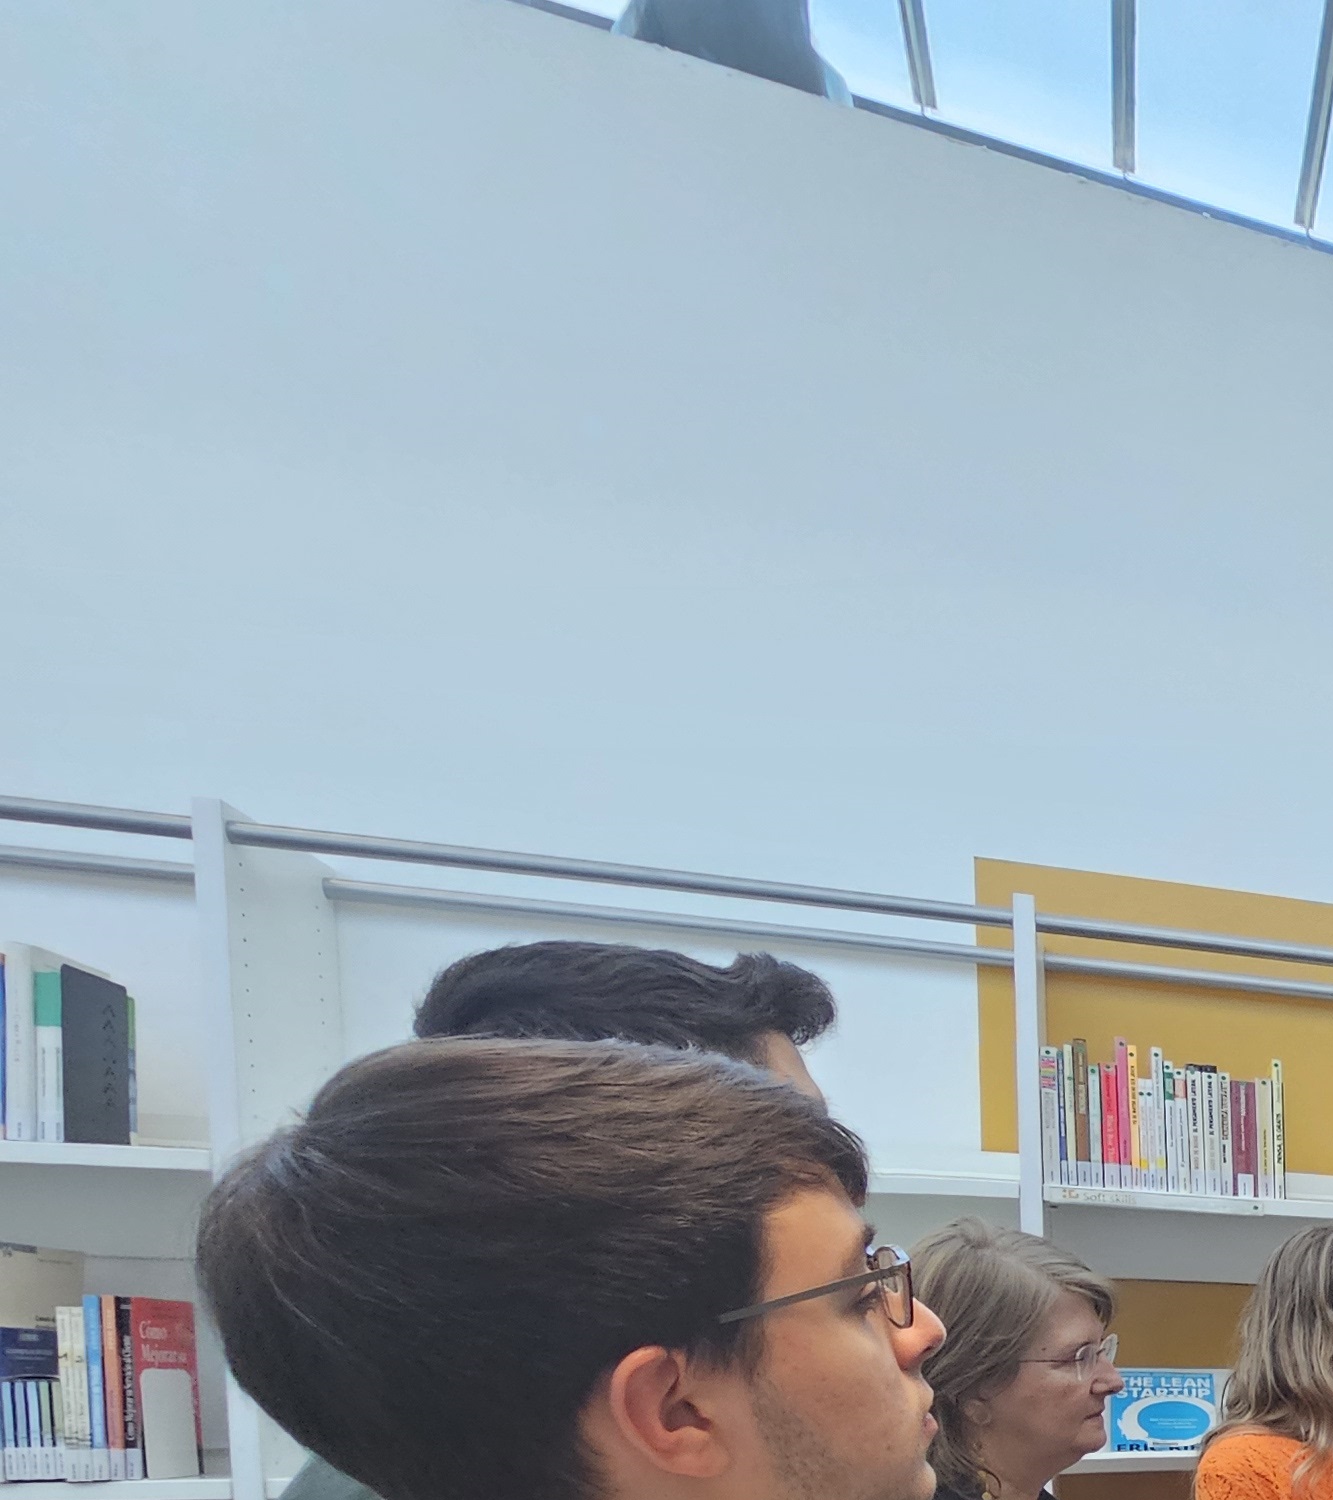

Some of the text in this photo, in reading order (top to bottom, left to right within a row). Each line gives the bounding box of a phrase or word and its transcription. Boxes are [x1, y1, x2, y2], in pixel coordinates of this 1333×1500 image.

[1083, 1192, 1105, 1203] Soft
[1120, 1376, 1211, 1389] THE LEAN
[1116, 1387, 1211, 1399] STARTUP
